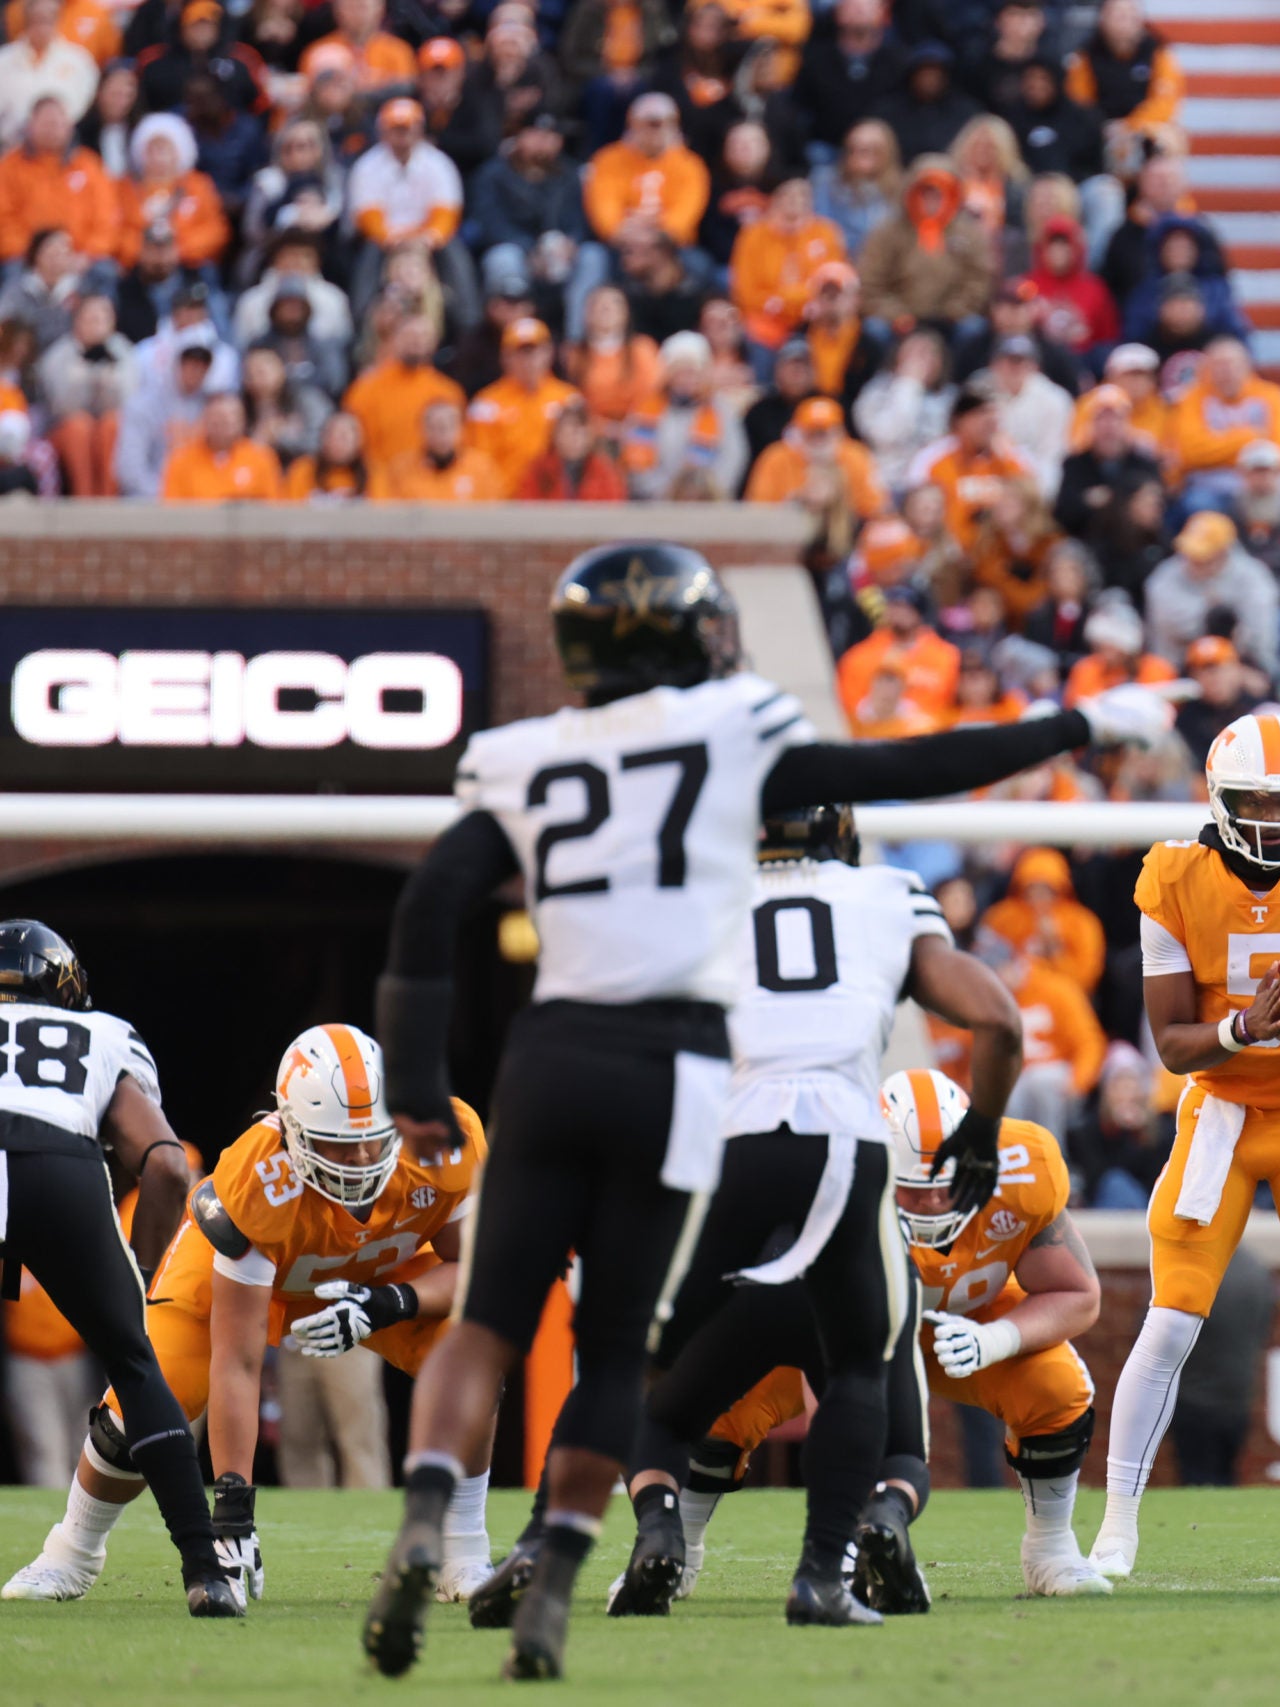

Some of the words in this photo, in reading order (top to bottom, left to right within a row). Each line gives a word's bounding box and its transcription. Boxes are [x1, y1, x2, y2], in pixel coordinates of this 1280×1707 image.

[11, 648, 463, 750] GEICO
[526, 741, 709, 905] 27
[1251, 906, 1268, 923] T
[753, 898, 839, 992] 0
[0, 1016, 91, 1096] 8
[279, 1047, 314, 1101] T
[254, 1150, 305, 1207] 53
[411, 1185, 436, 1209] SEC
[355, 1229, 372, 1244] T
[990, 1209, 1018, 1233] SEC
[940, 1262, 958, 1278] T
